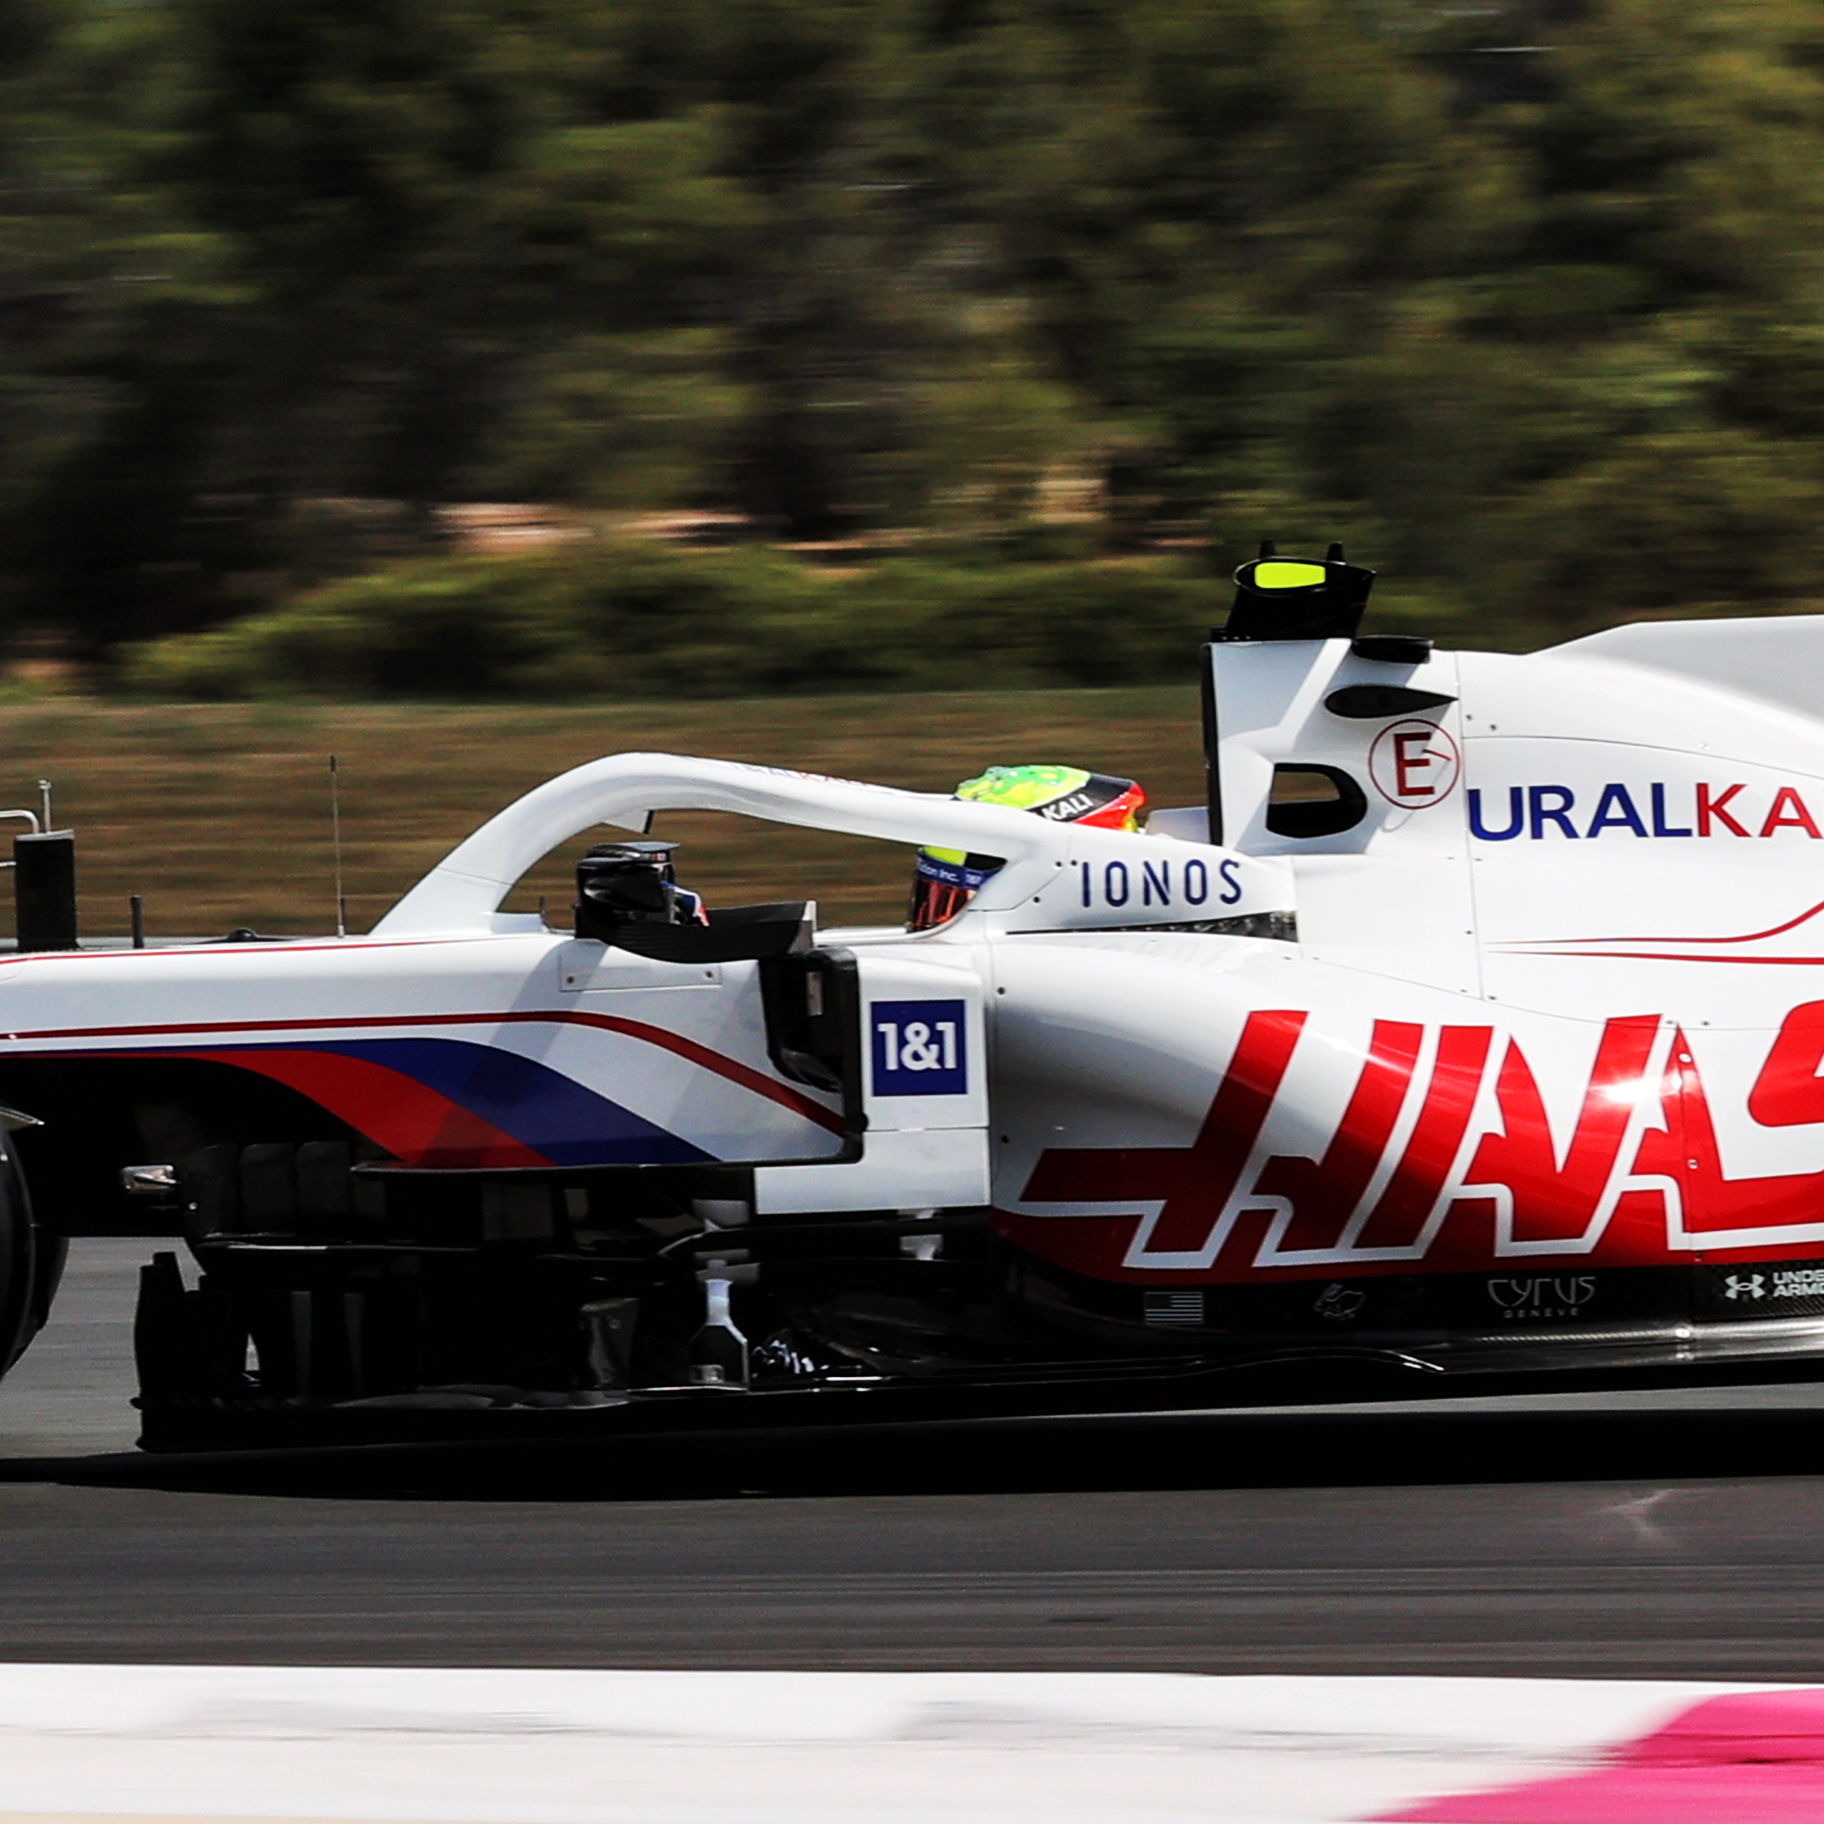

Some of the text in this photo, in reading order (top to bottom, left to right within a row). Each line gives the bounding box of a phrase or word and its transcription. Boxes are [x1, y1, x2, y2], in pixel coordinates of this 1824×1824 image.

[1394, 733, 1434, 796] E
[1083, 860, 1241, 907] IONOS
[878, 1022, 956, 1071] 1&1
